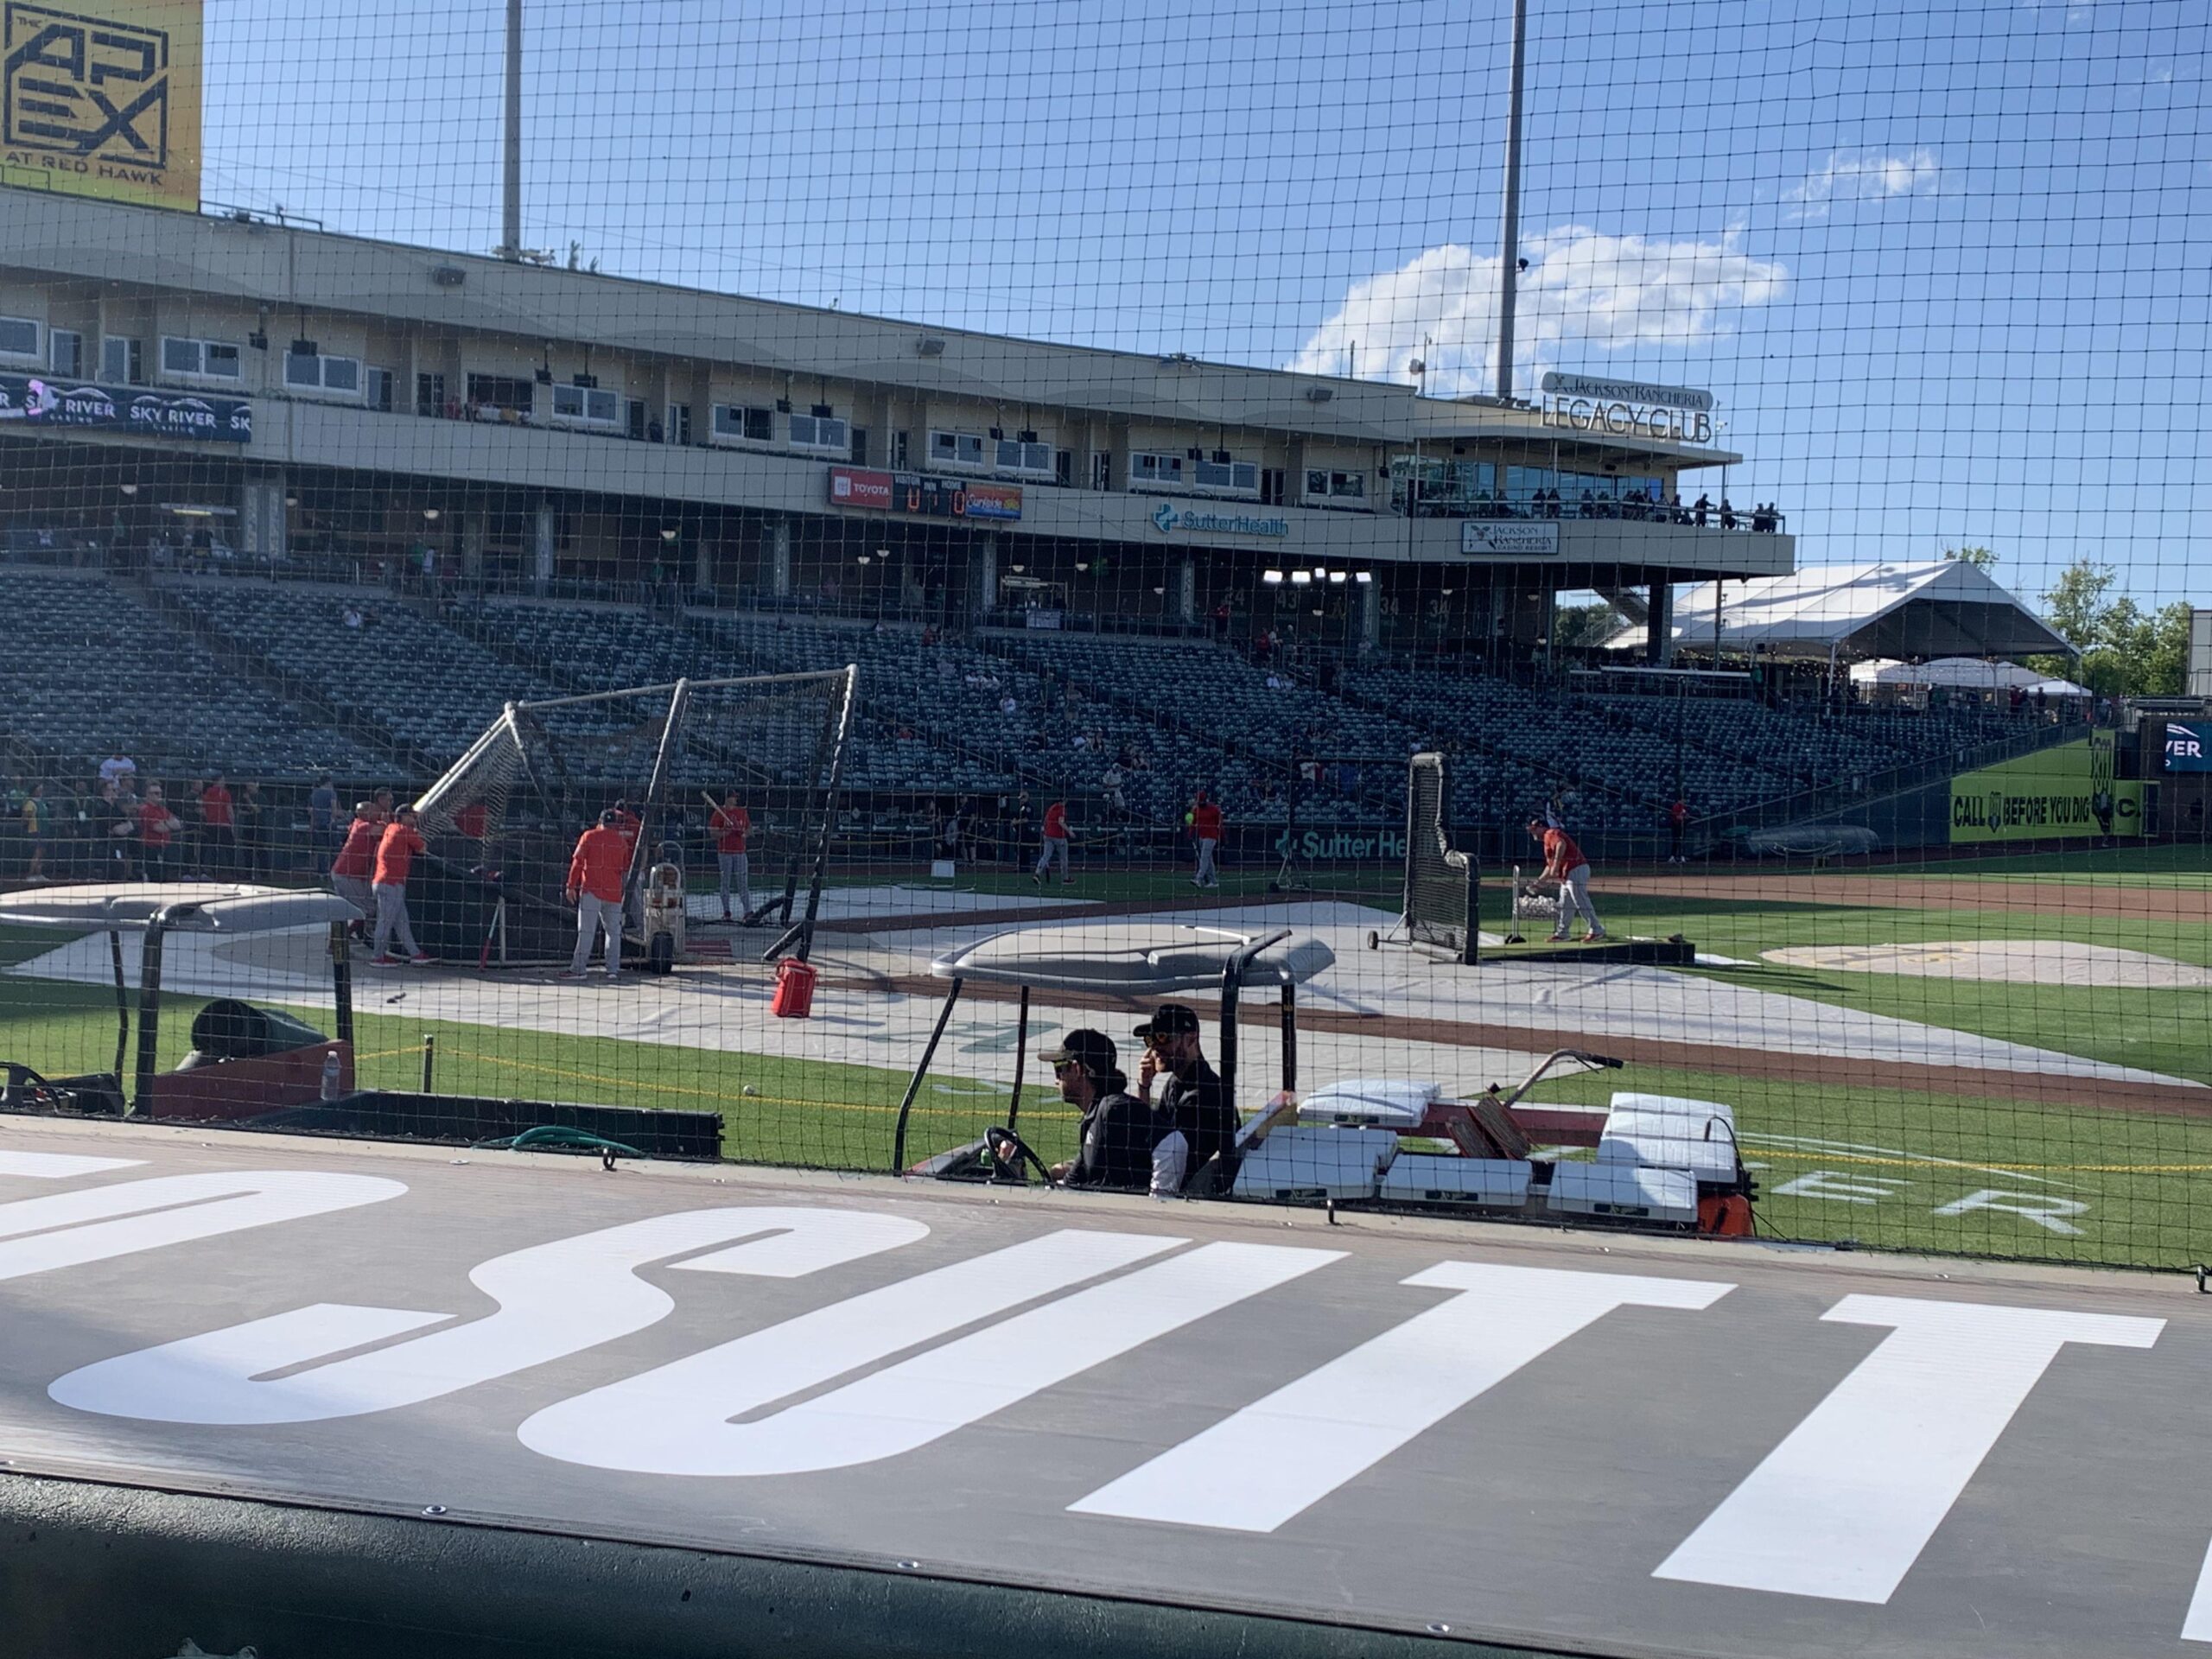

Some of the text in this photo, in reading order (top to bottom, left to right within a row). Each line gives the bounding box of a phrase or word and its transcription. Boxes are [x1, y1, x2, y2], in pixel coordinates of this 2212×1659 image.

[16, 16, 41, 29] THE
[6, 150, 162, 186] AT RED HAWK
[1570, 377, 1703, 408] JACKSON RANCHERIA
[66, 400, 116, 418] RIVER
[130, 405, 216, 429] SKY RIVER
[1541, 394, 1712, 443] LEGACY CLUB
[852, 483, 890, 496] TOYOTA
[894, 475, 921, 486] VISITOR
[941, 479, 962, 491] HOME
[953, 490, 965, 515] 0
[1953, 795, 1986, 828] CALL
[2004, 795, 2048, 826] BEFORE
[2050, 795, 2072, 824] YOU
[2073, 794, 2090, 823] DIG
[1301, 830, 1376, 858] Sutter
[48, 1206, 2212, 1642] SUTT
